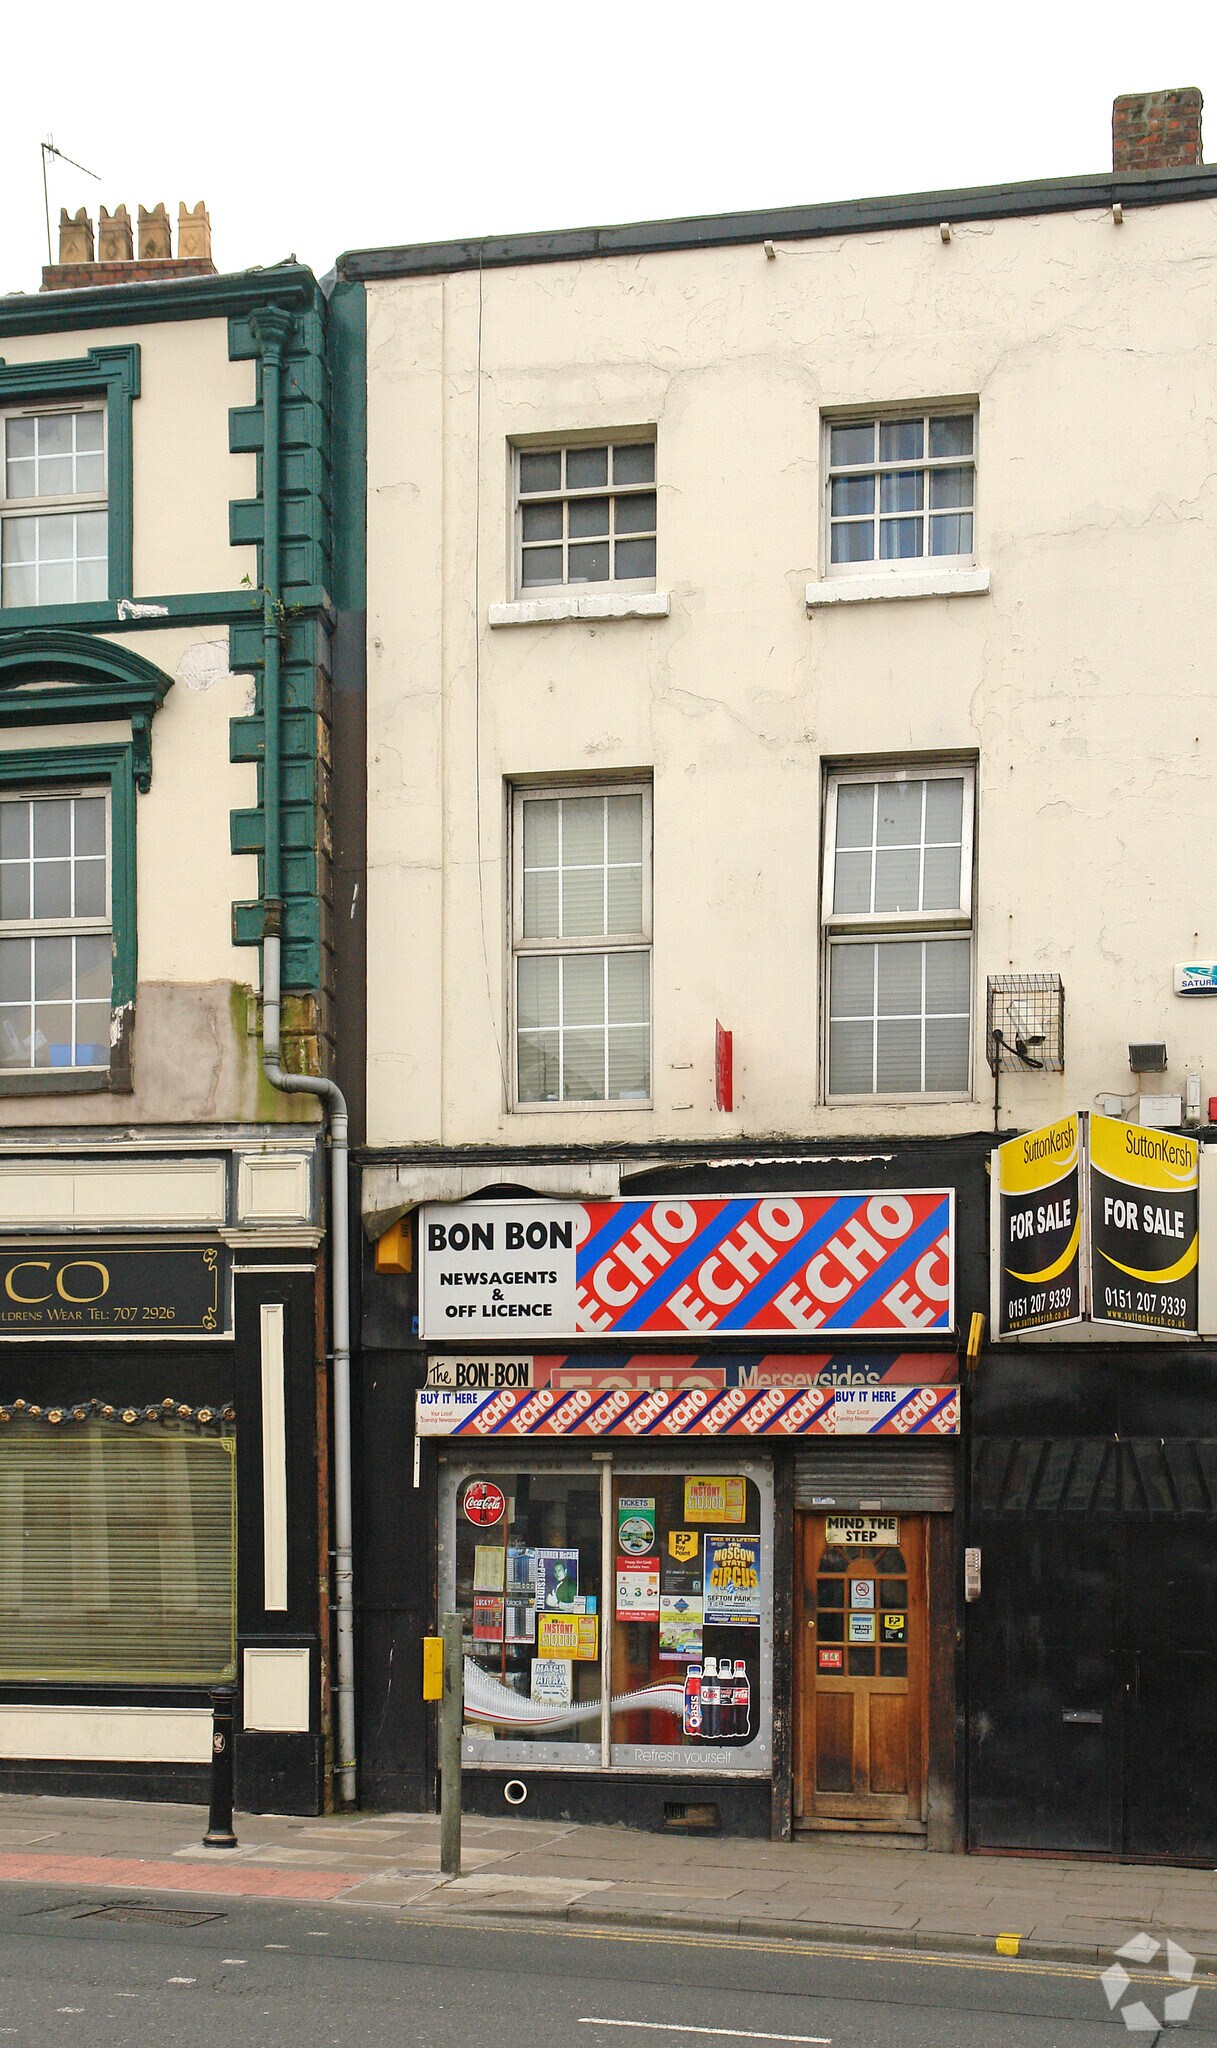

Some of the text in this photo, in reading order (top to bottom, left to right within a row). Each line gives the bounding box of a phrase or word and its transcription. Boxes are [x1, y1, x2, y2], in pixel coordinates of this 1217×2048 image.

[1023, 1122, 1076, 1164] SuttonKersh
[1126, 1129, 1193, 1168] SuttonKersh
[1010, 1198, 1072, 1243] FOR SALE
[1104, 1197, 1185, 1239] FOR SALE
[428, 1223, 494, 1251] BON
[505, 1221, 573, 1250] BON
[576, 1201, 698, 1332] ECHO
[666, 1197, 804, 1330] ECHO
[773, 1195, 914, 1329] ECHO
[5, 1260, 110, 1304] CO
[440, 1271, 557, 1285] NEWSAGENTS
[882, 1235, 949, 1328] EC
[492, 1288, 504, 1301] &
[1008, 1287, 1072, 1319] 0151 207 9339
[1105, 1286, 1187, 1317] 0151 207 9339
[113, 1308, 138, 1321] 707
[142, 1306, 175, 1319] 2926
[445, 1304, 552, 1318] OFF LICENCE
[1009, 1311, 1071, 1330] www.suttonkersh.co.uk
[1107, 1309, 1186, 1328] www.suttonkersh.co.uk
[429, 1362, 451, 1384] The
[420, 1393, 478, 1404] BUY IT HERE
[472, 1390, 516, 1433] ECHO
[510, 1390, 554, 1433] ECHO
[547, 1390, 592, 1434] ECHO
[585, 1390, 630, 1434] ECHO
[624, 1390, 669, 1434] ECHO
[662, 1390, 707, 1434] ECHO
[700, 1389, 746, 1433] ECHO
[740, 1389, 785, 1433] ECHO
[778, 1389, 824, 1433] ECHO
[836, 1391, 896, 1403] BUY IT HERE
[890, 1388, 938, 1433] ECHO
[687, 1496, 725, 1510] £10,000
[690, 1486, 720, 1497] INSTANT
[827, 1517, 896, 1530] MIND THE
[846, 1531, 877, 1542] STEP
[713, 1547, 755, 1563] MOSCOW
[710, 1567, 759, 1588] CIRCUS
[541, 1634, 578, 1647] £10,000
[544, 1624, 573, 1634] INSTANT
[535, 1664, 566, 1673] MATCH
[536, 1674, 566, 1685] ATTAX
[689, 1695, 699, 1728] Oasis
[634, 1748, 732, 1765] Refresh yourself
